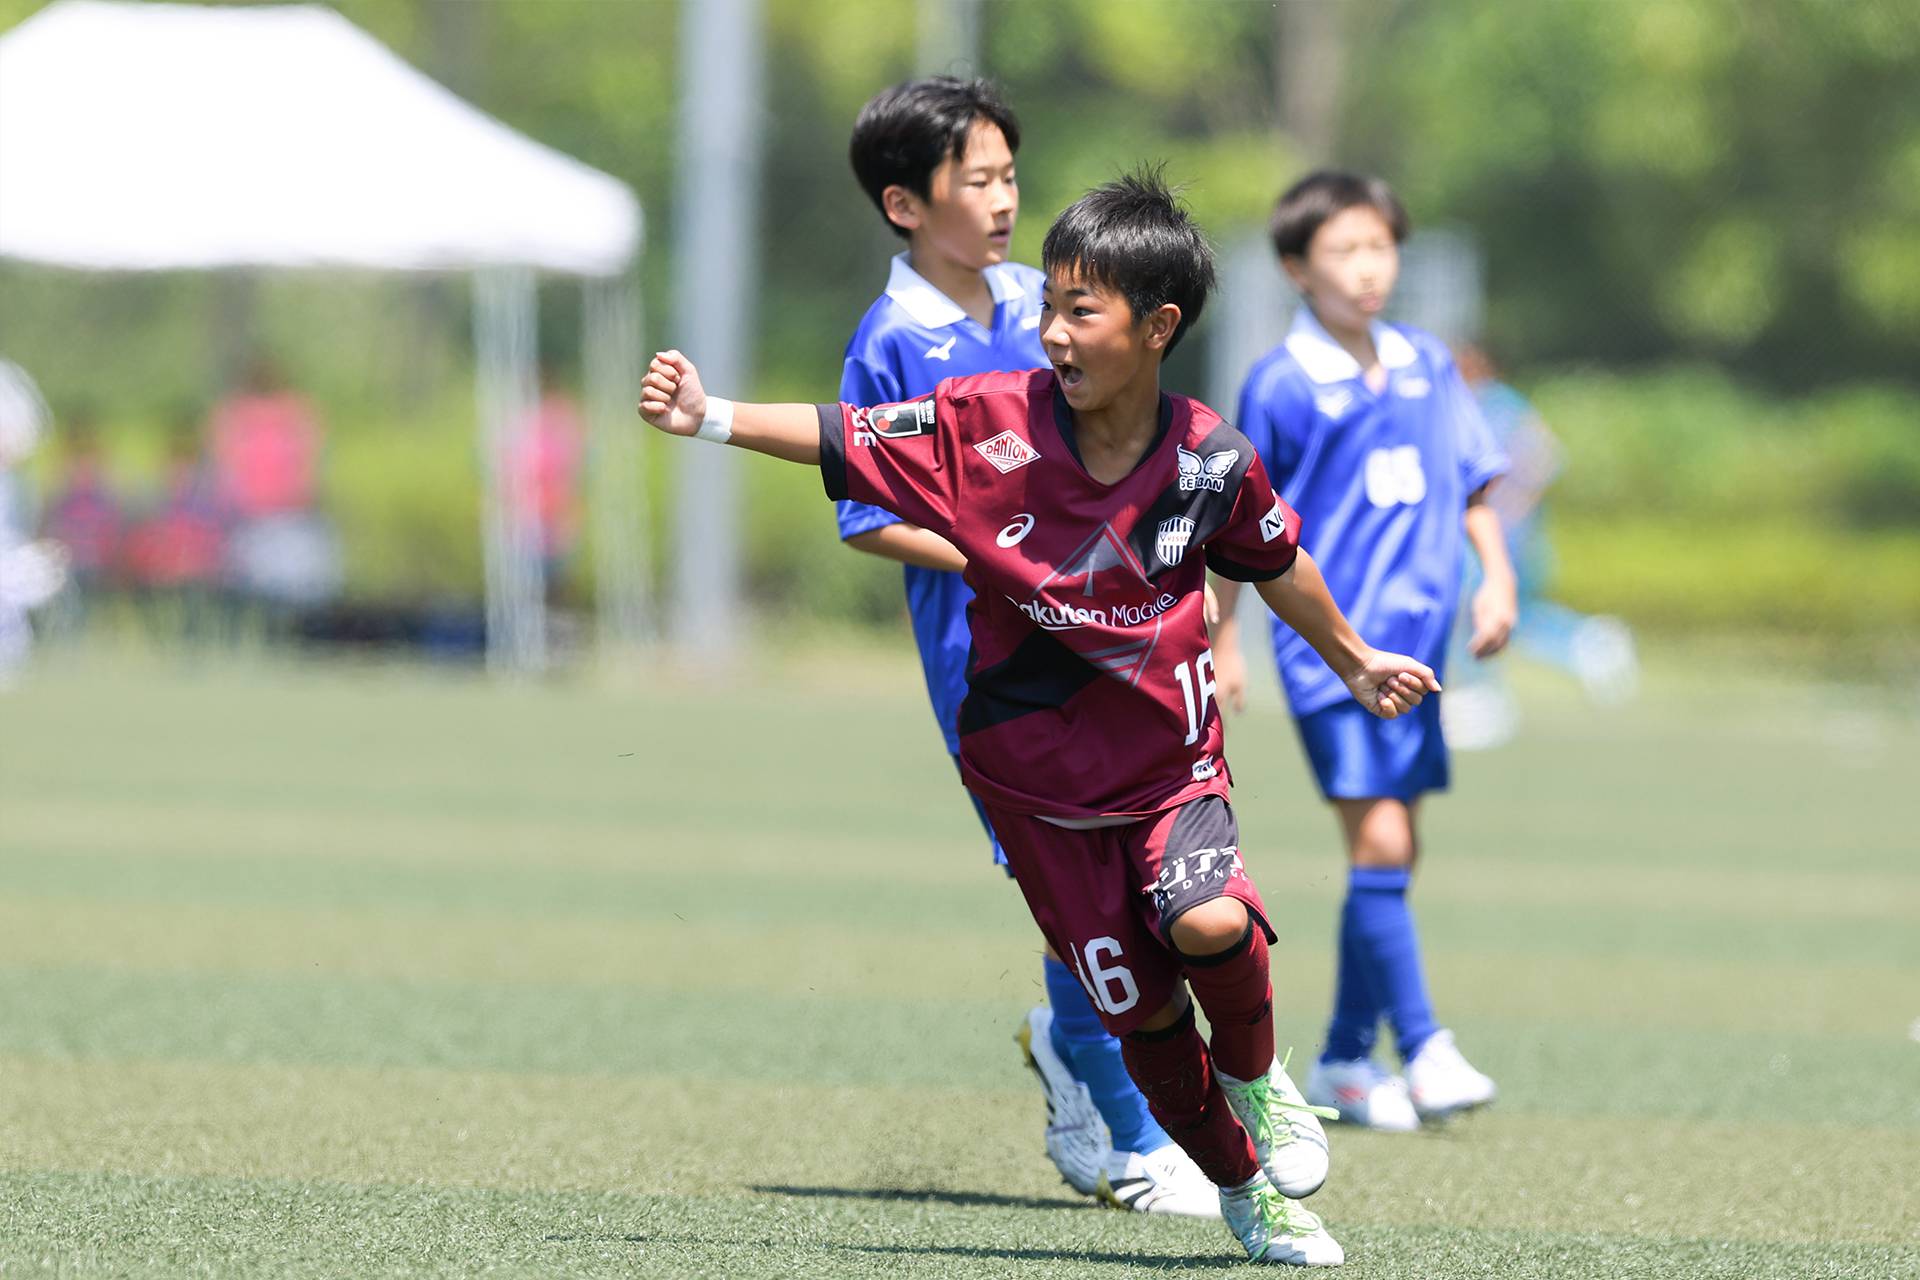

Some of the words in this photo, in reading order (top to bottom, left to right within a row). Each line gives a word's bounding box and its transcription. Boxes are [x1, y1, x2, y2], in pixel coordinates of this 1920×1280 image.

[986, 436, 1028, 459] DANTON
[1008, 596, 1107, 626] akuten
[1111, 592, 1178, 627] Mobile
